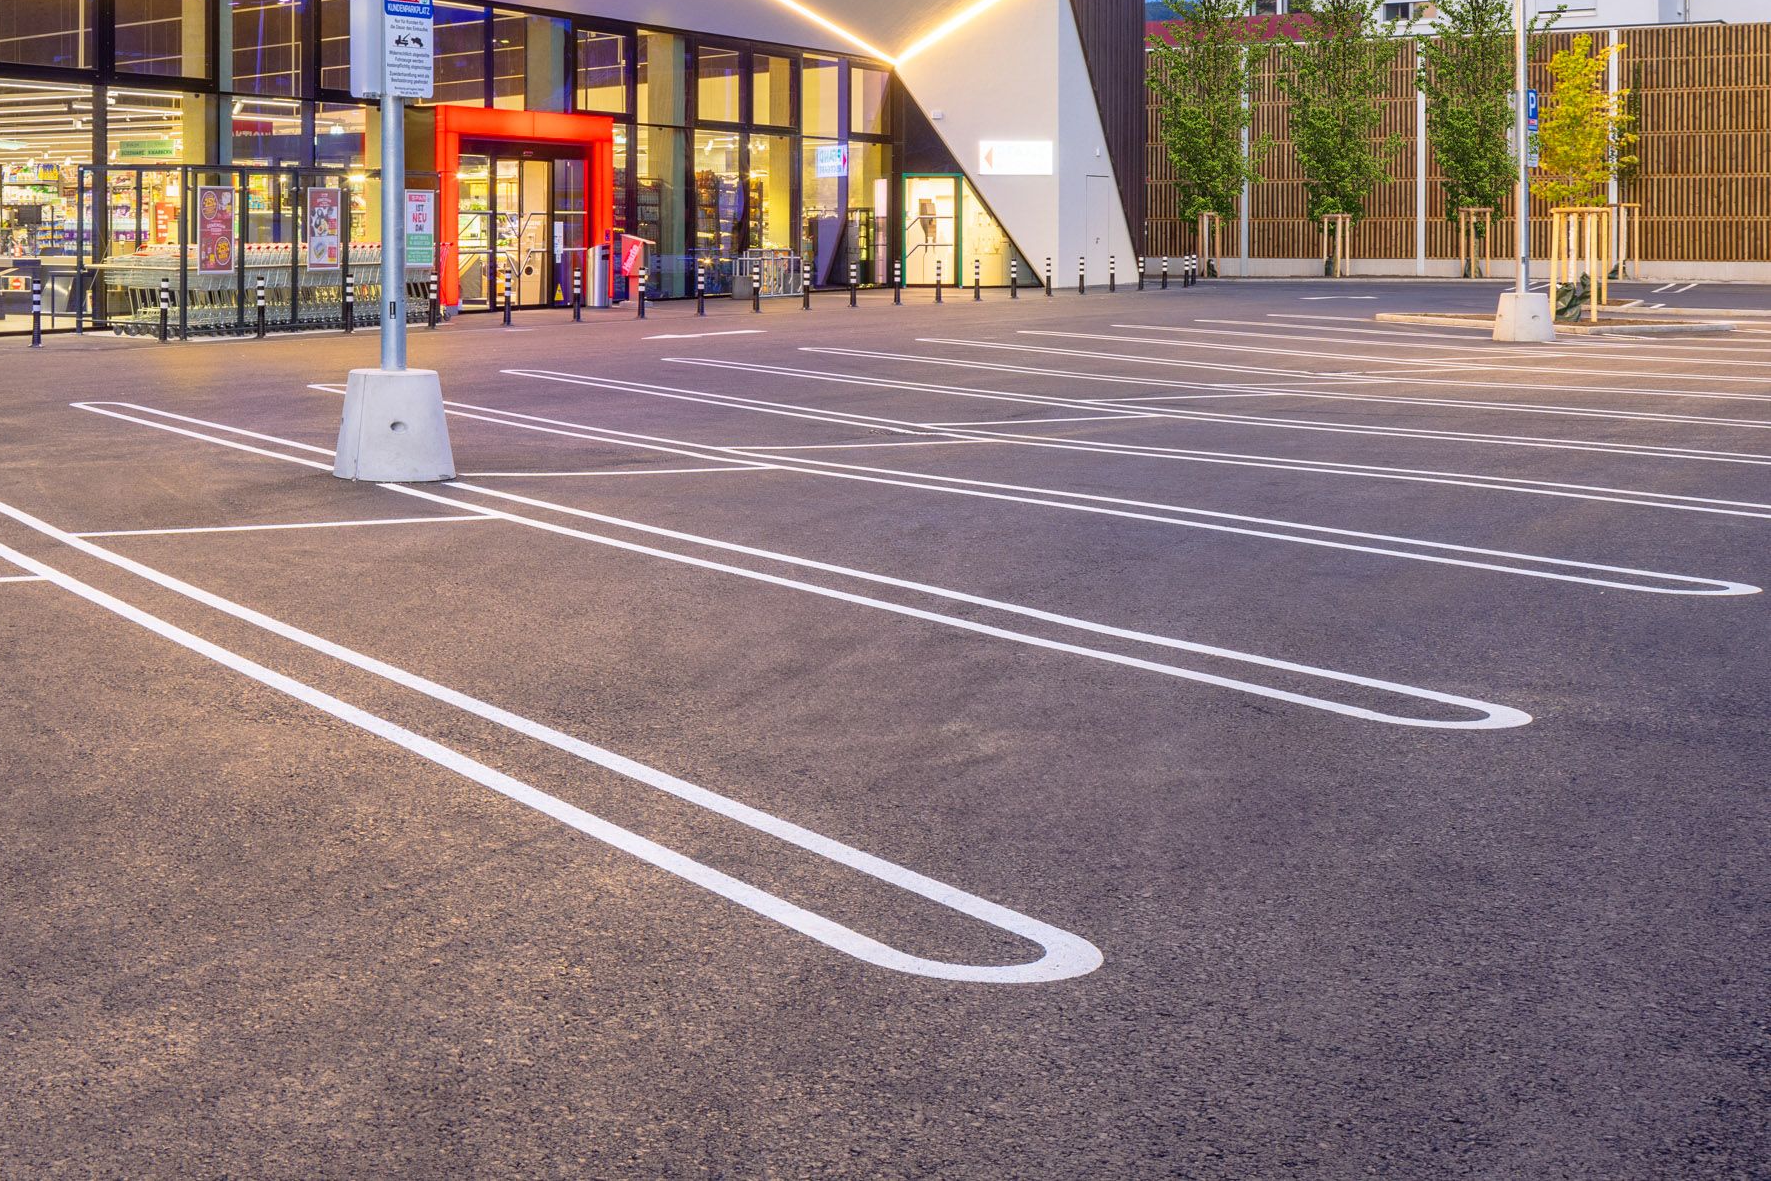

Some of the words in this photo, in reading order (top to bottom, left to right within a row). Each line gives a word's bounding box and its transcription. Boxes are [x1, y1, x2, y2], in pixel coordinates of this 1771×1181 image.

[388, 3, 430, 16] KUNDENPARKPLATZ
[1529, 92, 1536, 117] P
[415, 204, 424, 212] IST
[412, 213, 427, 223] NEU
